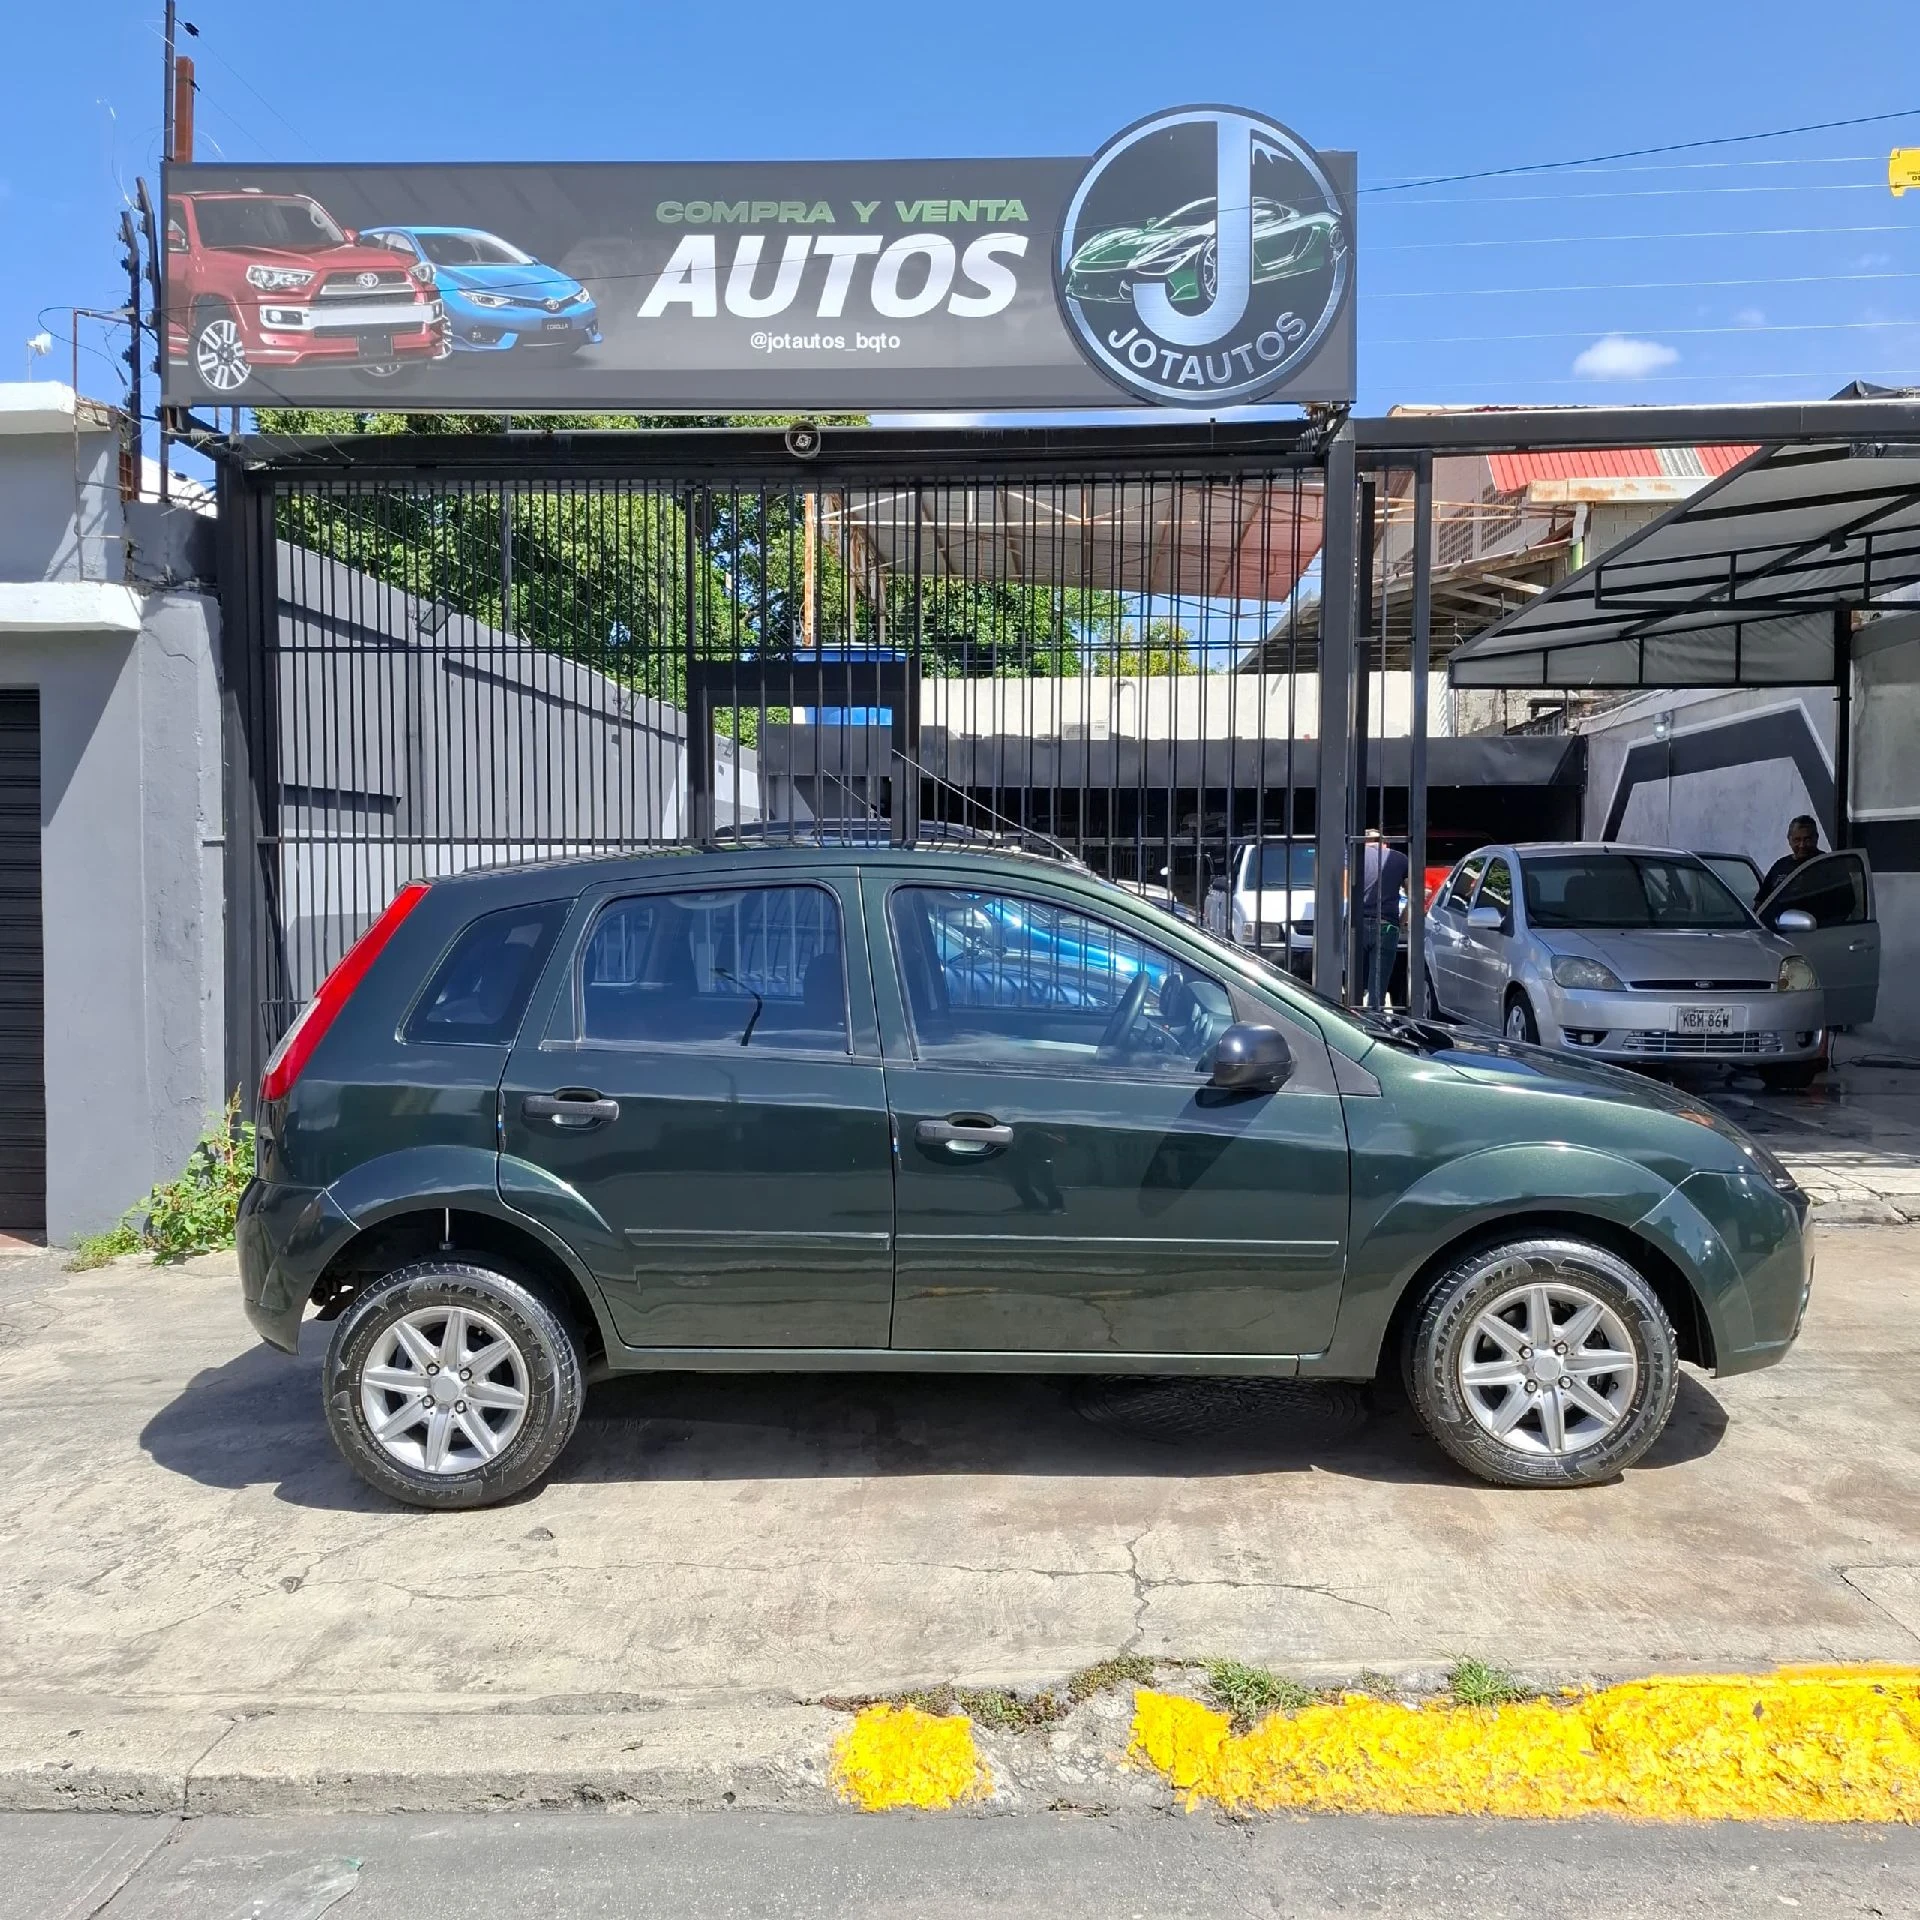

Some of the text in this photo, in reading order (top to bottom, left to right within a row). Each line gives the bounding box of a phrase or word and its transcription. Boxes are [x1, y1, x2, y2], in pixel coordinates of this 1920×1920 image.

[656, 200, 1029, 223] COMPRA Y VENTA
[636, 232, 1029, 318] AUTOS
[750, 332, 901, 353] @jotautos_bqto
[1108, 311, 1307, 385] JOTAUTOS
[439, 1282, 548, 1361] MAXTREK
